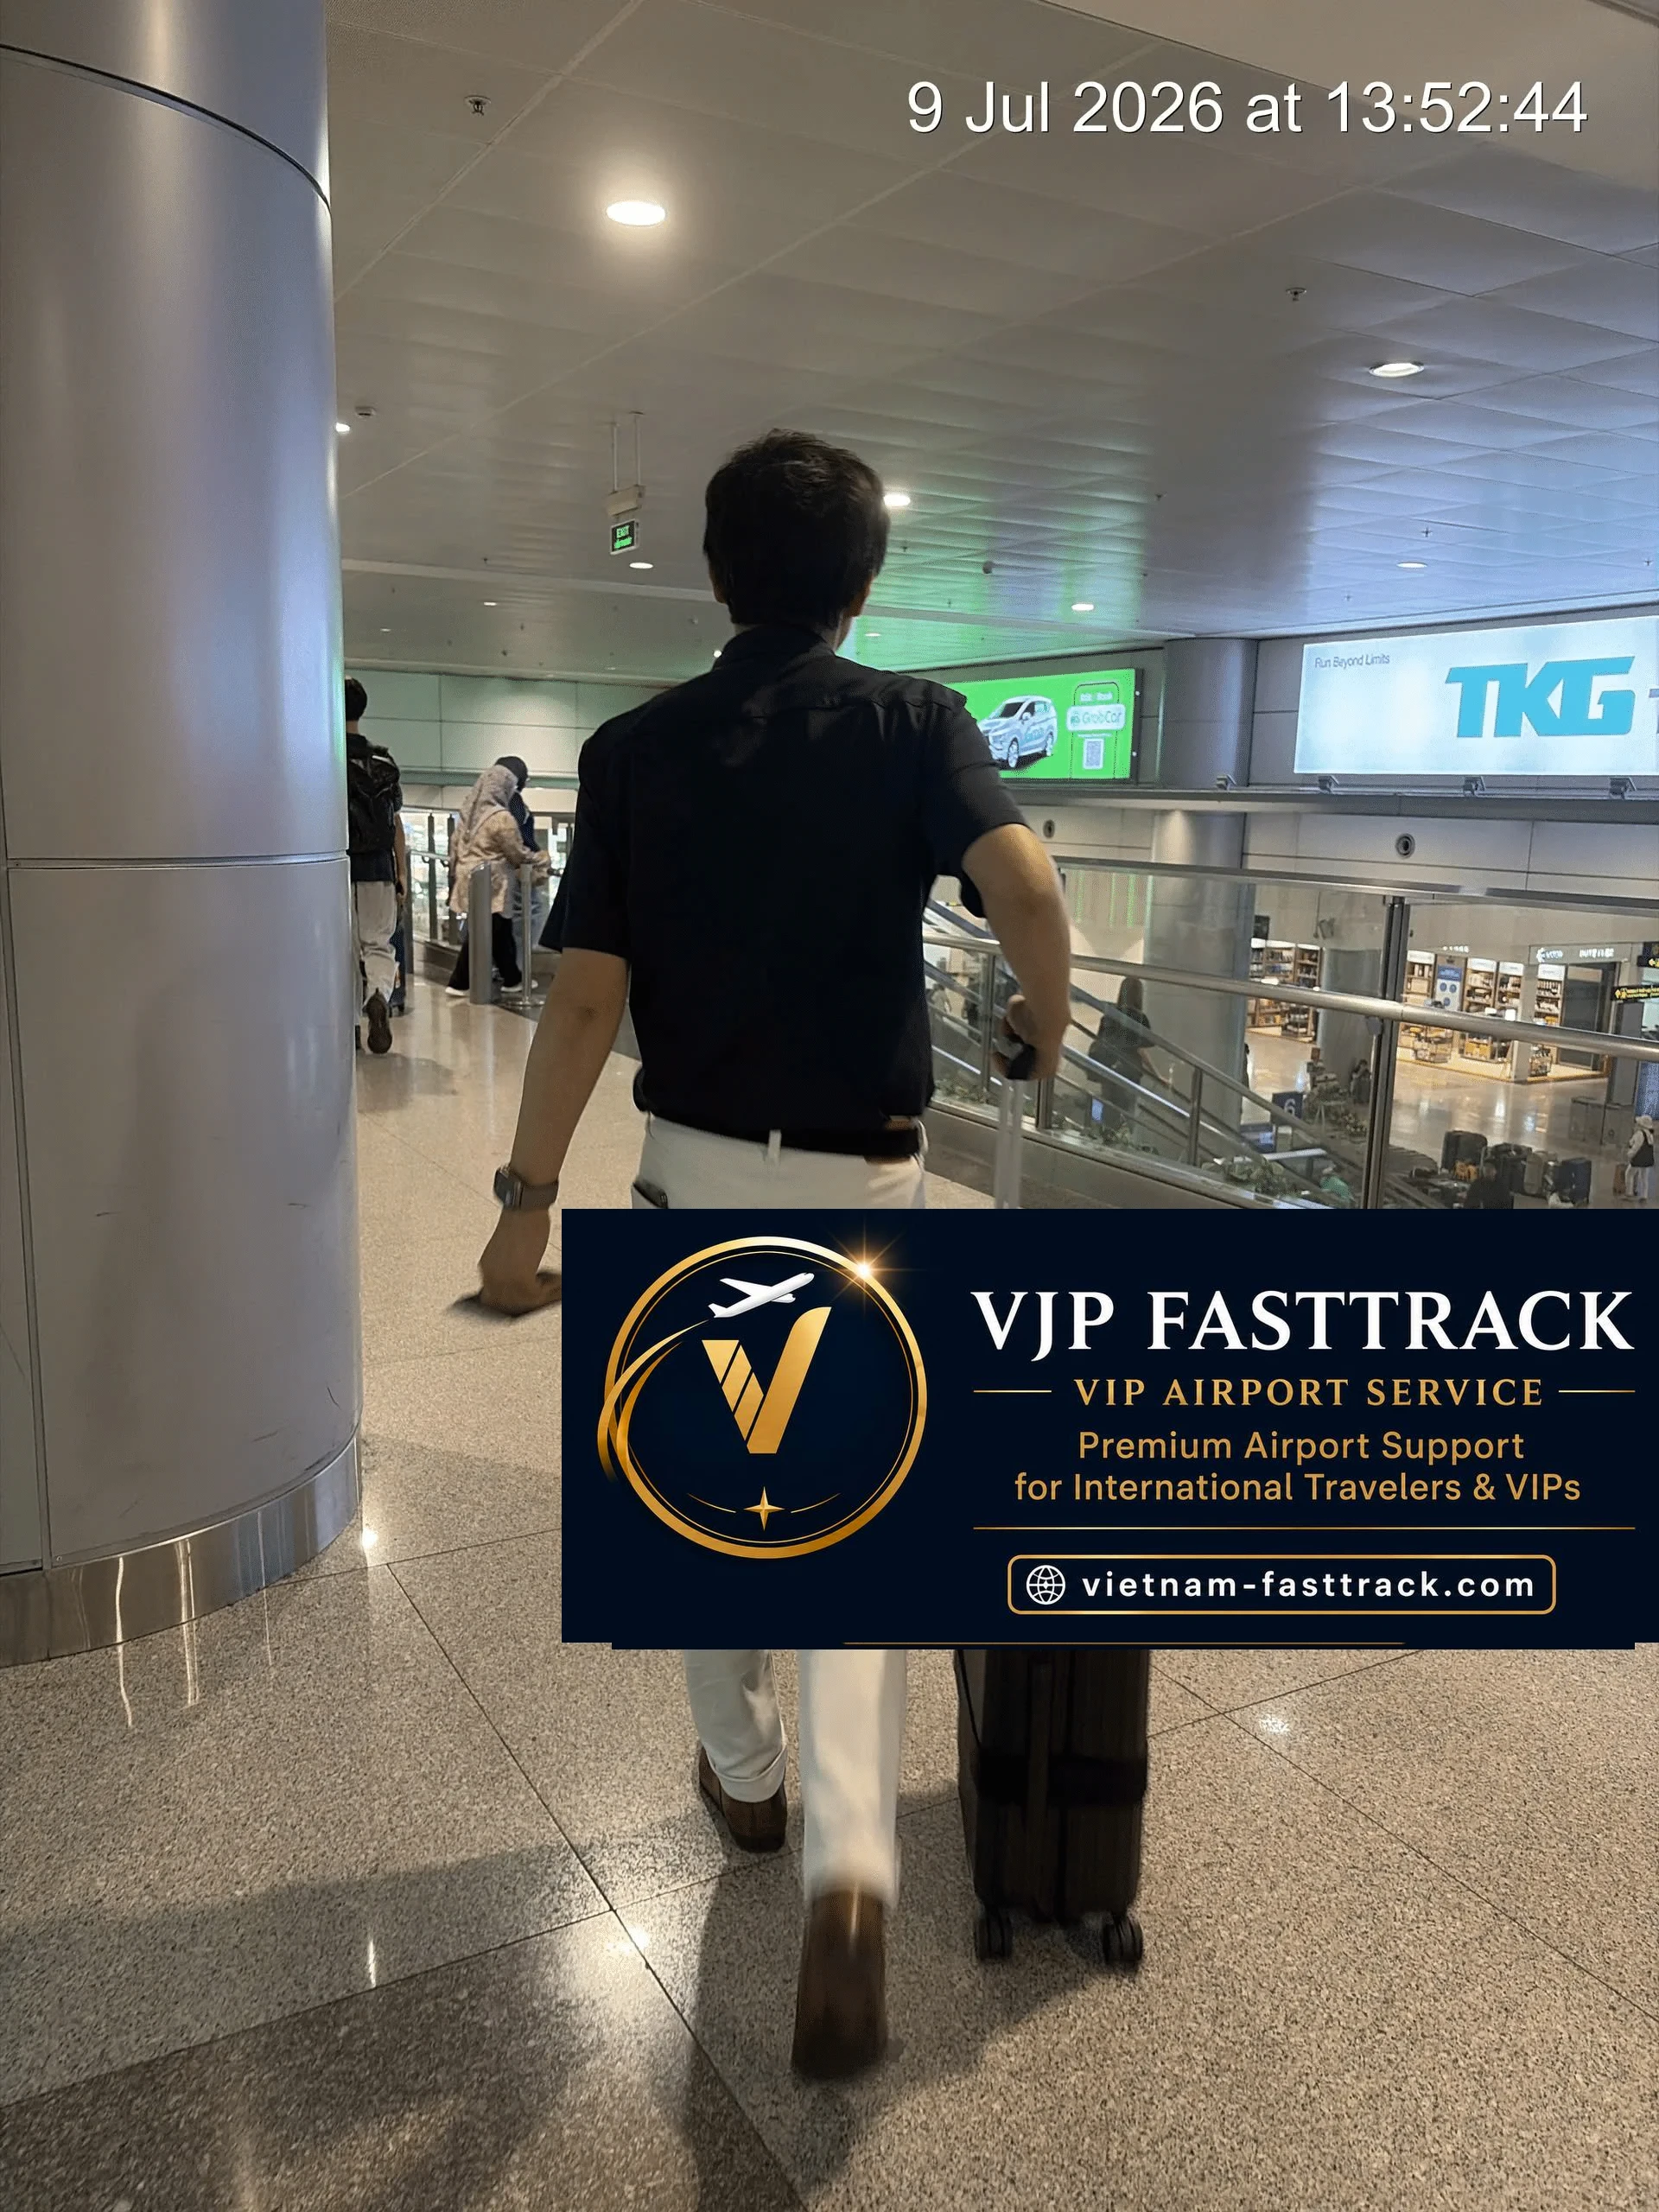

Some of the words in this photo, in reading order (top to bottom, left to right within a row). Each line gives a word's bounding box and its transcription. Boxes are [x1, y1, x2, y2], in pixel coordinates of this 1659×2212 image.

[1315, 658, 1332, 668] Run
[1333, 654, 1363, 670] Beyond
[1365, 653, 1390, 665] Limits
[1445, 656, 1636, 738] TKG
